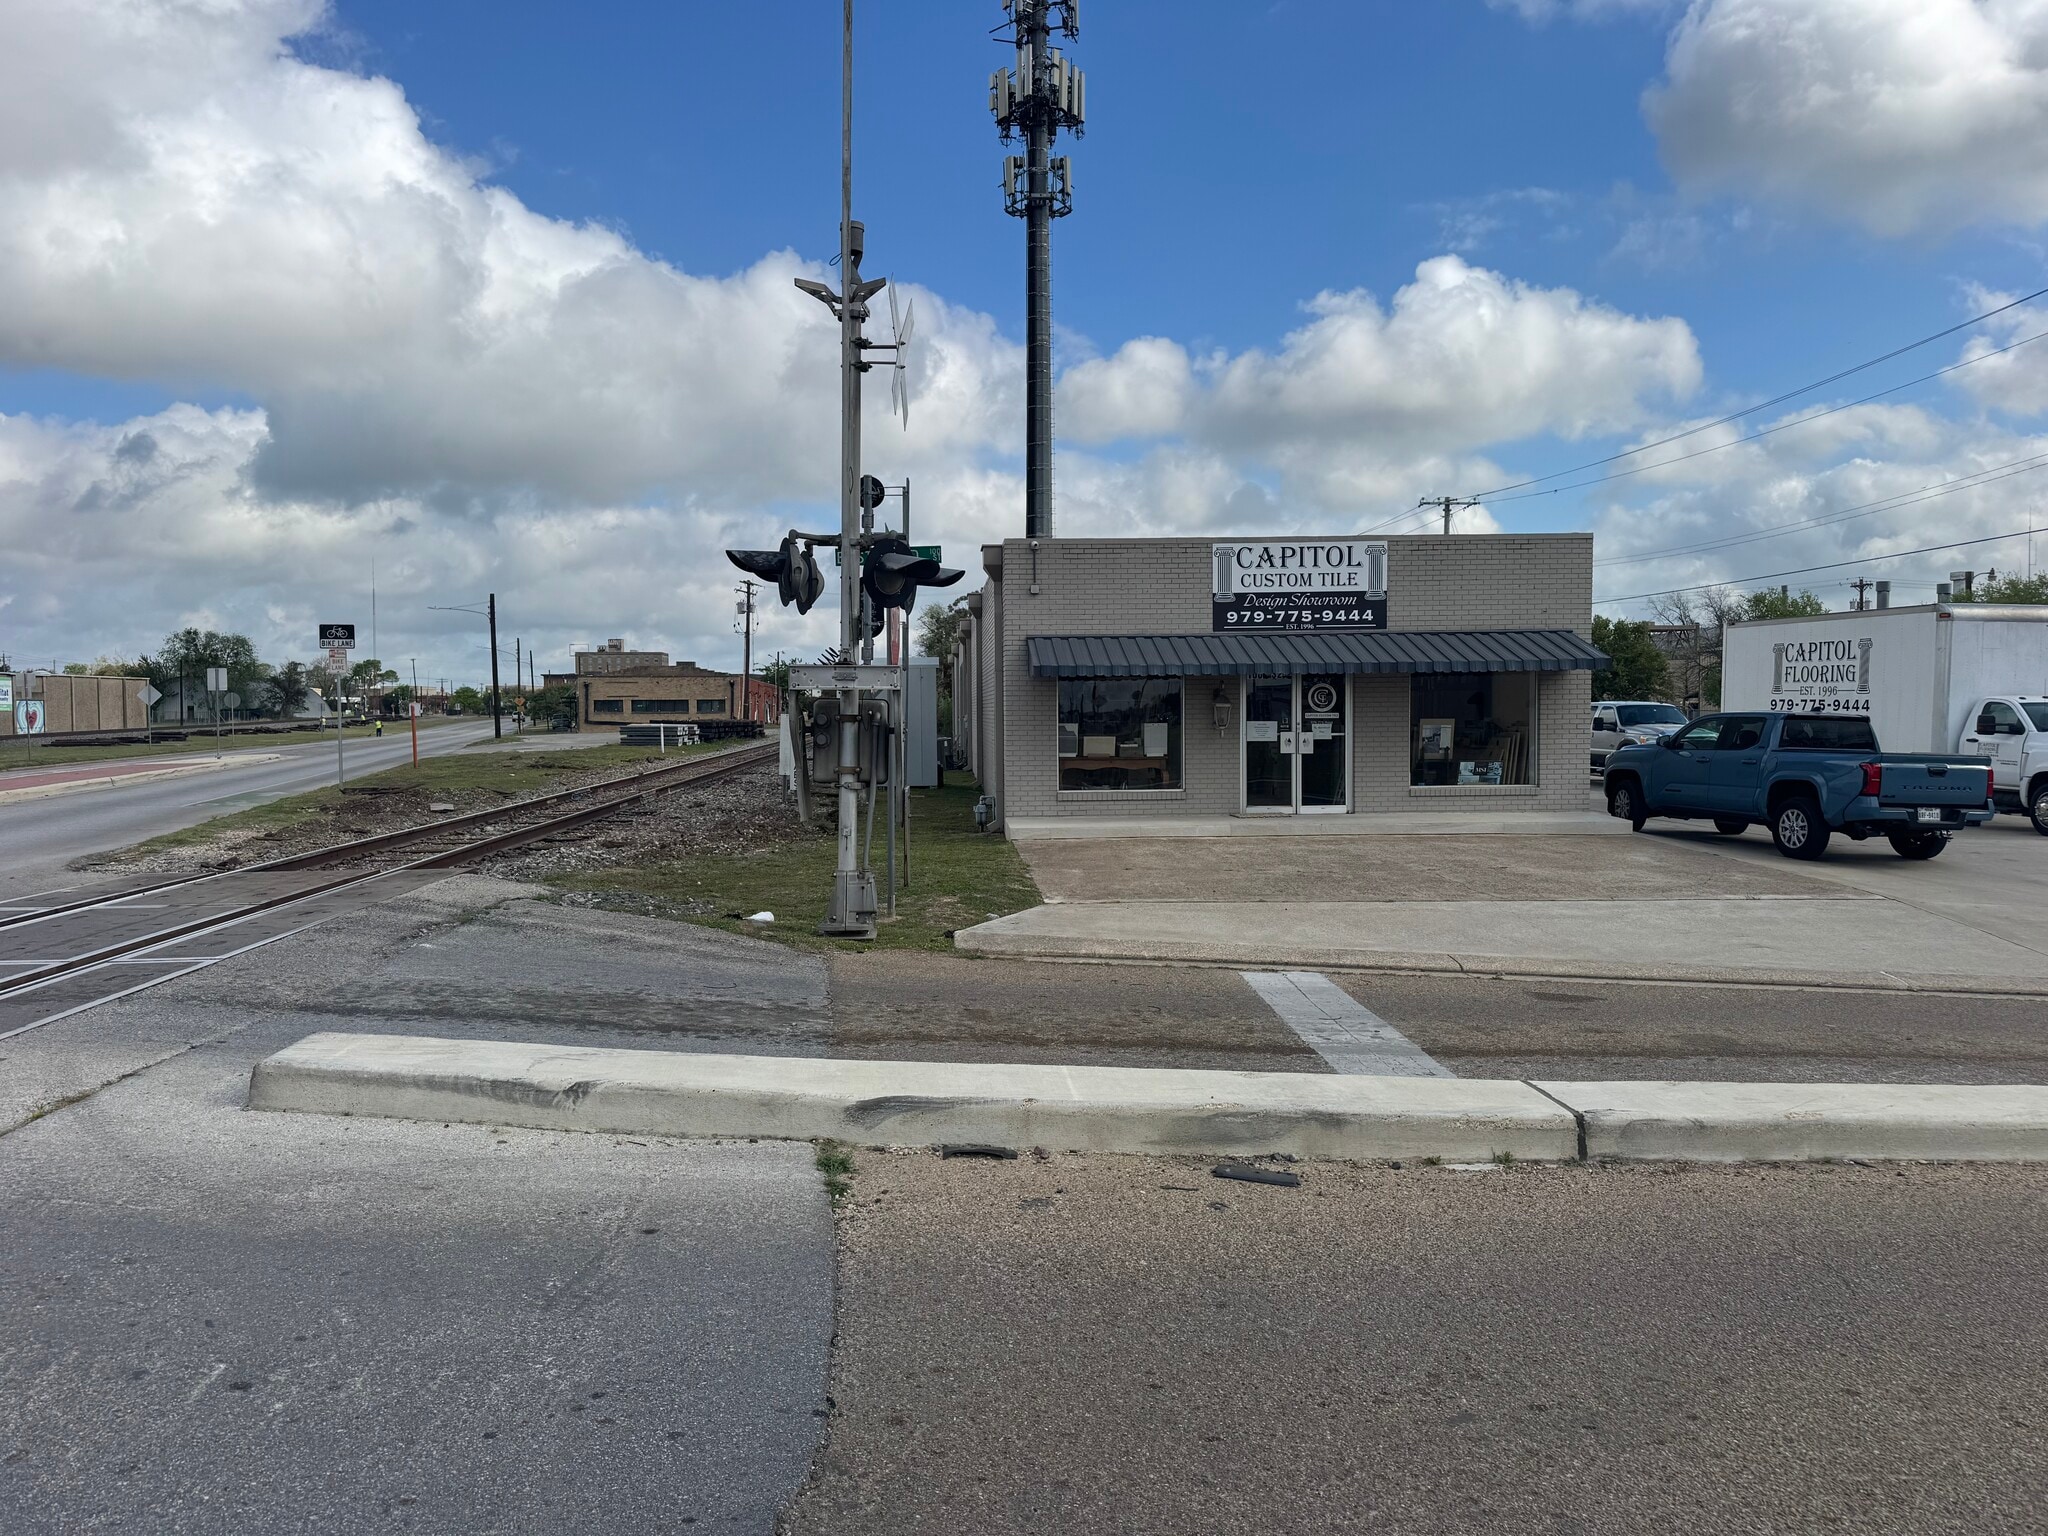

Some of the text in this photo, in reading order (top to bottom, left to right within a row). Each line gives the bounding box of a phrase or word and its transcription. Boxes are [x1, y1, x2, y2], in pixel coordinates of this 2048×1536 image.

[1236, 545, 1364, 569] CAPITOL
[1240, 572, 1358, 588] CUSTOM TILE
[1243, 593, 1357, 610] Design Showroom
[1226, 609, 1374, 623] 979-775-9444
[1785, 640, 1856, 662] CAPITOL
[1784, 664, 1857, 684] FLOORING
[1799, 686, 1838, 697] EST. 1996
[1770, 699, 1870, 712] 979-775-9444
